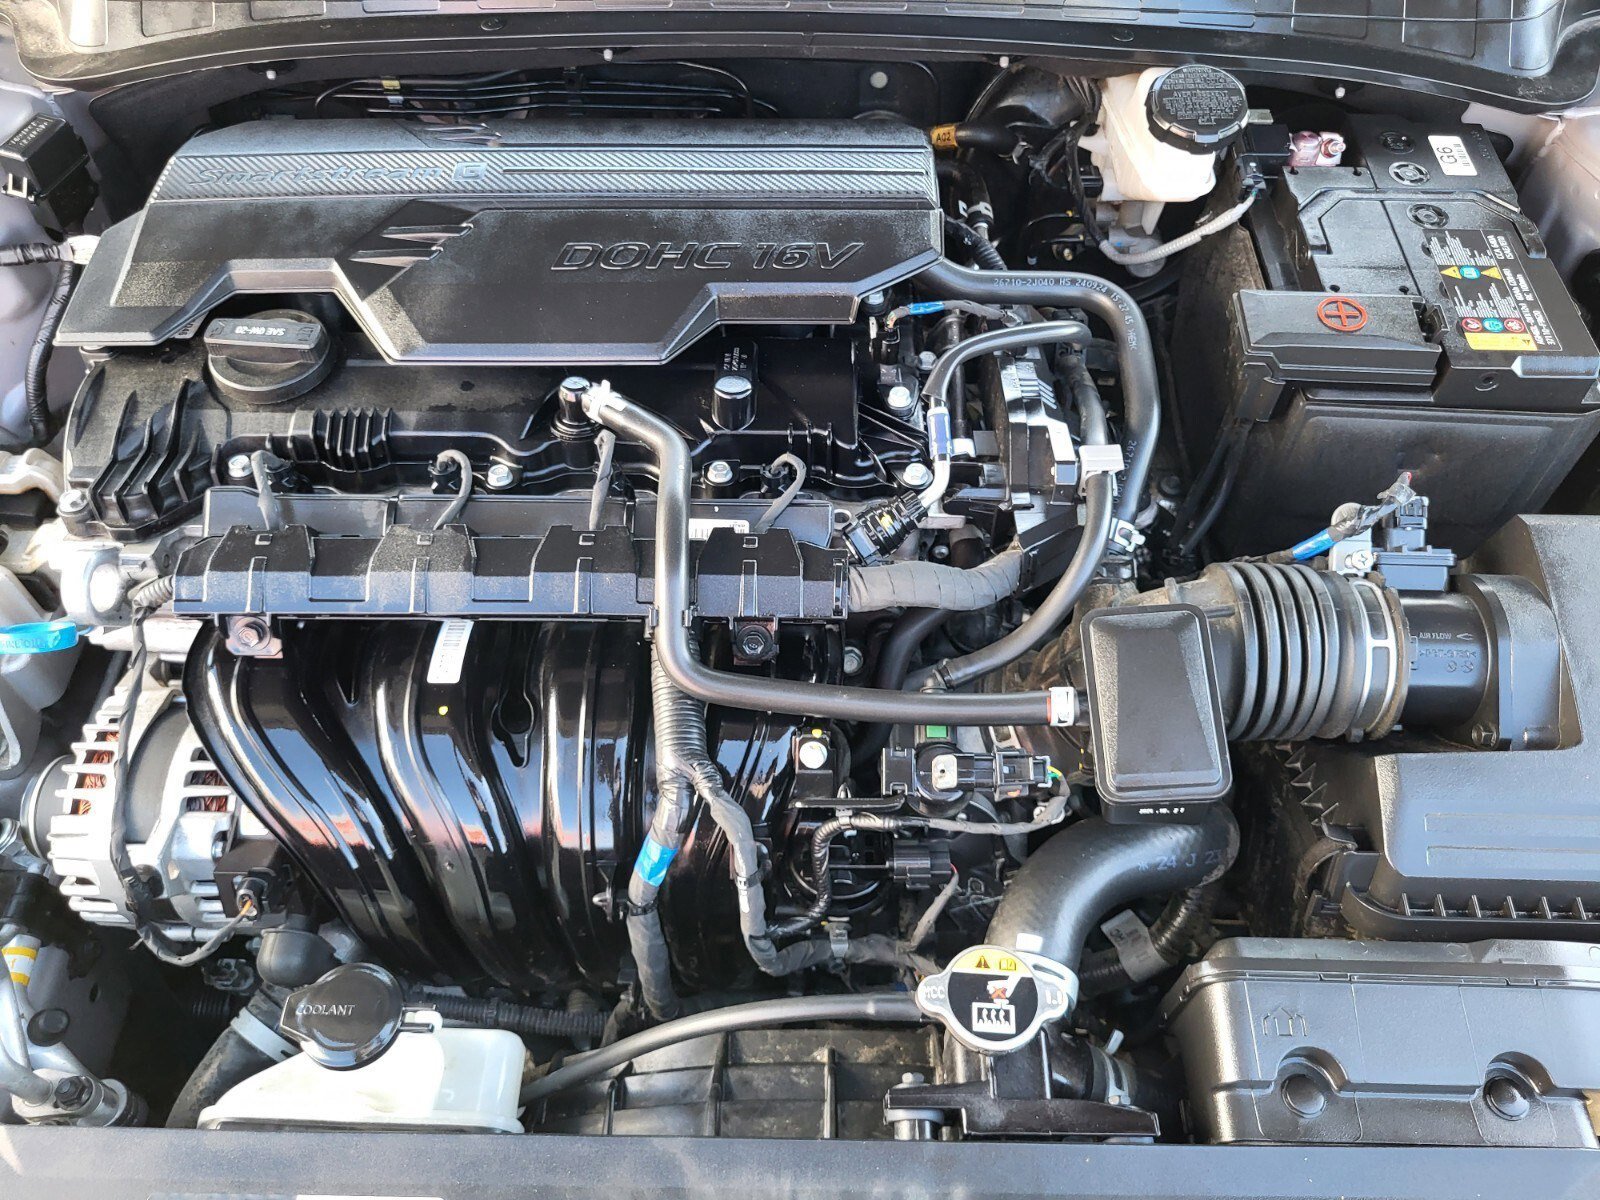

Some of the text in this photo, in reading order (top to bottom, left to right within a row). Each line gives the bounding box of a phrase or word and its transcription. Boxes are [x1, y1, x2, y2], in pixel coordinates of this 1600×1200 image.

[1436, 146, 1458, 164] G6
[190, 164, 445, 186] Smartstream
[550, 241, 865, 270] DOHC 16V
[295, 1004, 356, 1016] COOLANT
